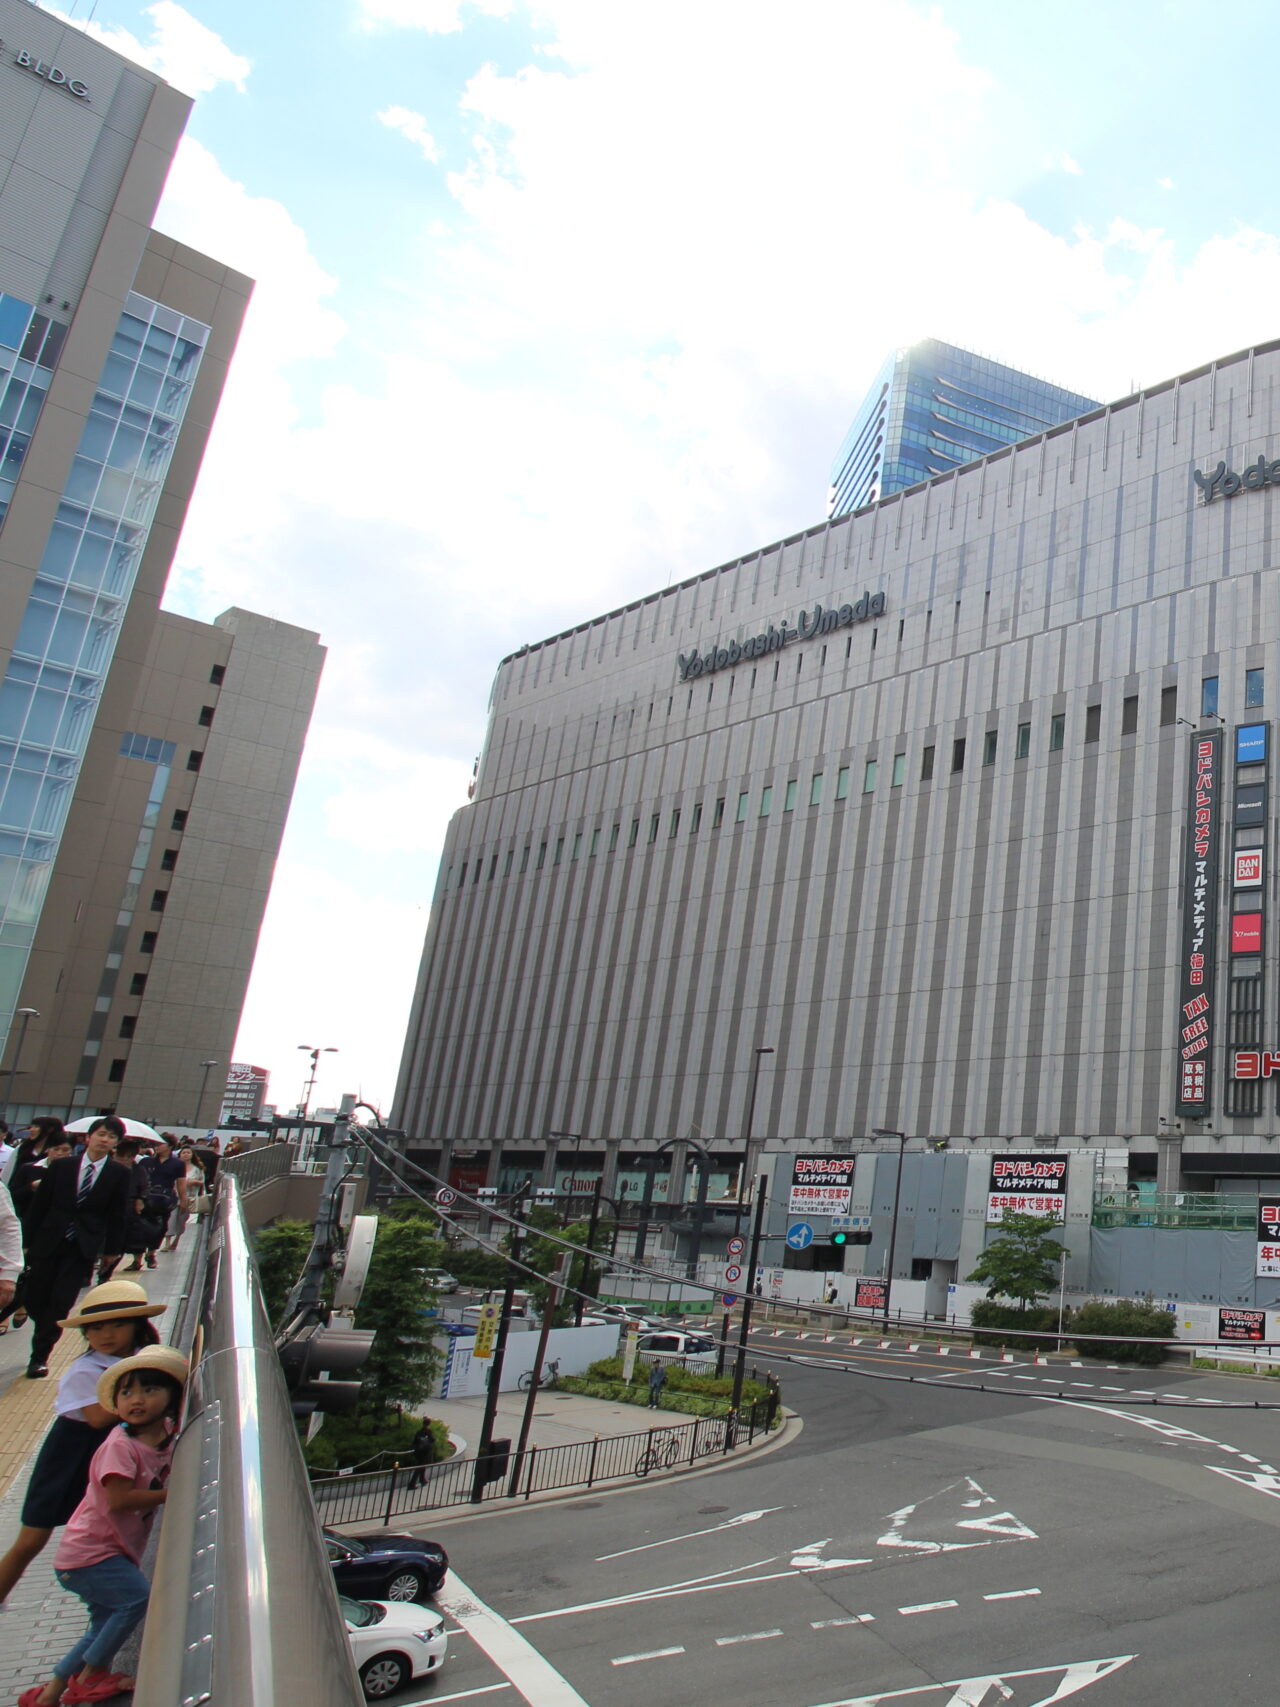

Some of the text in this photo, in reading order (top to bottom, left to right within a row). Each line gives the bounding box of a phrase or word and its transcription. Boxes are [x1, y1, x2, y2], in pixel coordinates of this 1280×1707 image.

[678, 591, 885, 681] Yodobashi-Umeda
[1237, 801, 1262, 809] Microsoft
[1238, 859, 1258, 868] BAN
[1238, 868, 1254, 877] DAI
[1183, 993, 1209, 1020] TAX
[1182, 1017, 1208, 1043] FREE
[1182, 1036, 1208, 1060] STORE
[227, 1072, 265, 1081] センター
[795, 1159, 854, 1173] ヨドバシカメラ
[993, 1161, 1066, 1177] ヨドバシカメラ
[561, 1176, 597, 1192] Canon
[629, 1182, 638, 1191] LG
[792, 1187, 849, 1200] 年中無休で営業中
[990, 1196, 1062, 1211] 年中無休で営業中
